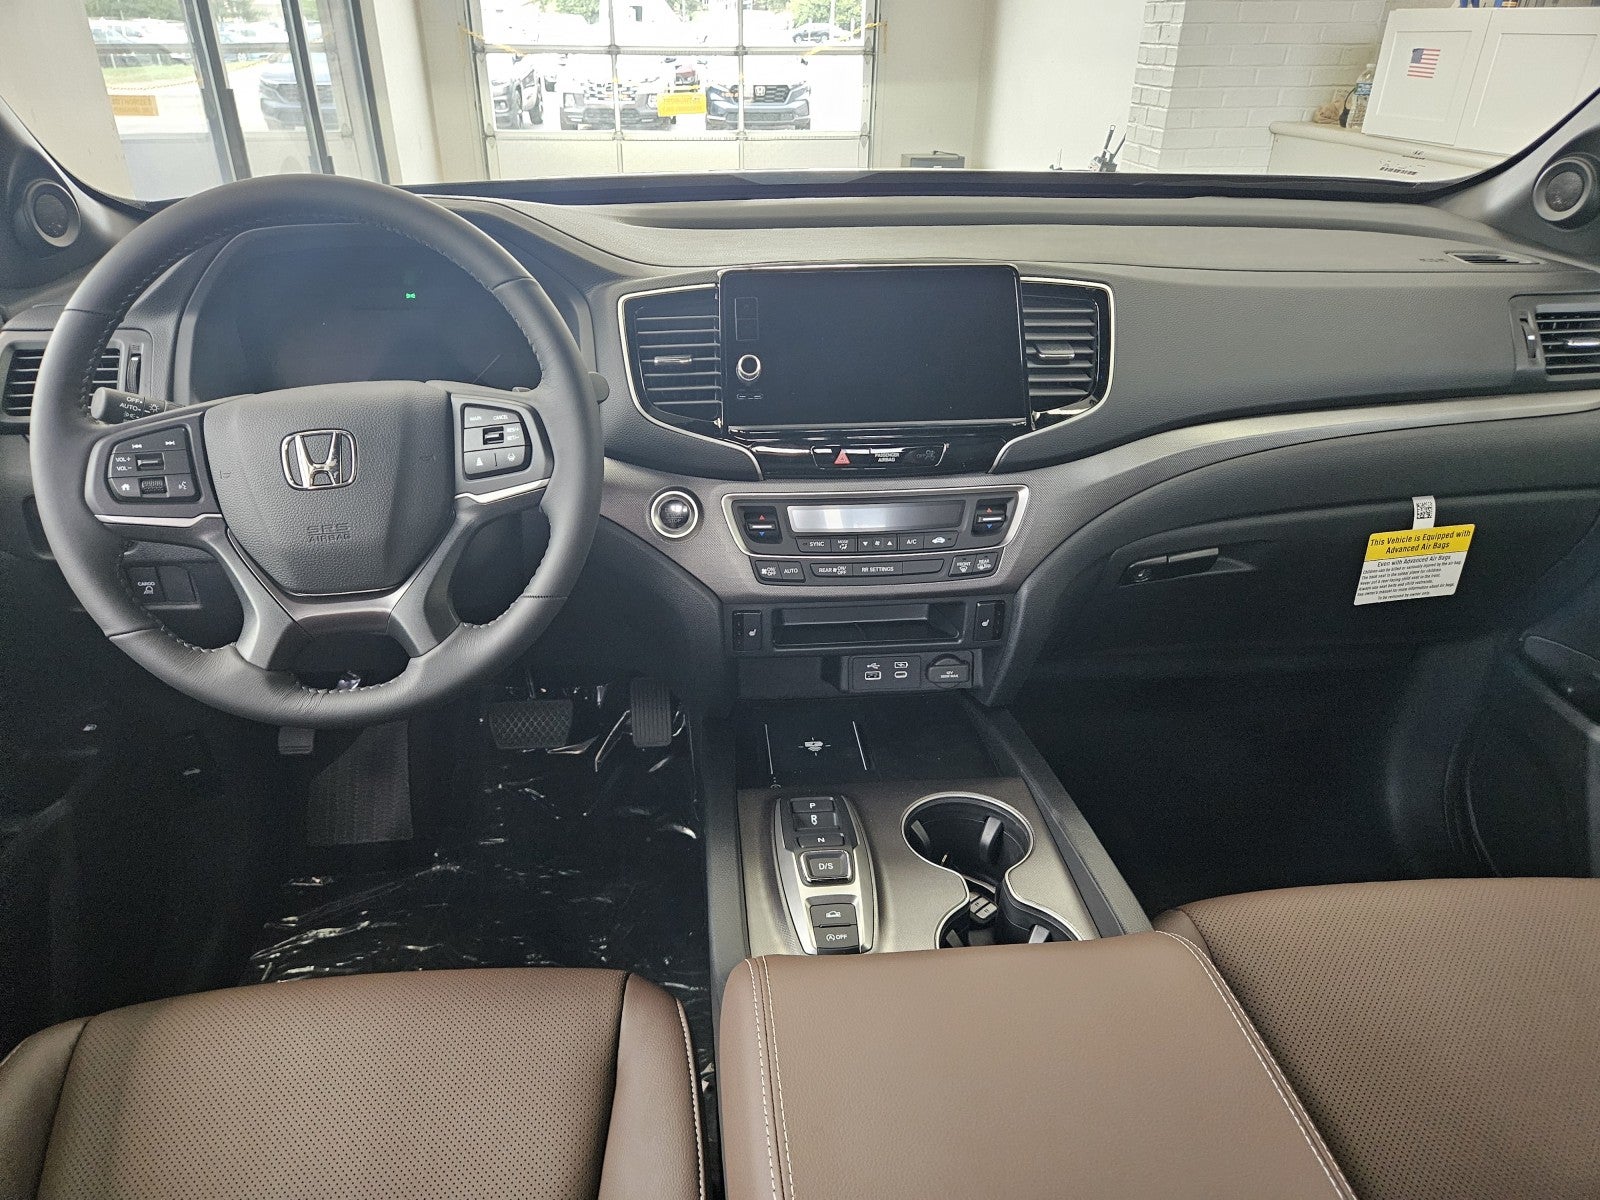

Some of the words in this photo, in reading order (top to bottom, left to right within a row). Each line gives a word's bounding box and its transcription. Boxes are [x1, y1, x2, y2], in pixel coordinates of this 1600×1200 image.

[120, 402, 138, 411] AUTO
[1371, 538, 1385, 546] This
[1387, 535, 1412, 544] Vehicle
[1422, 531, 1454, 541] Equipped
[1456, 530, 1470, 538] with
[1386, 543, 1420, 554] Advanced
[1421, 542, 1431, 550] Air
[1432, 541, 1450, 550] Bags
[1403, 557, 1428, 565] Advanced
[818, 862, 834, 870] D/S
